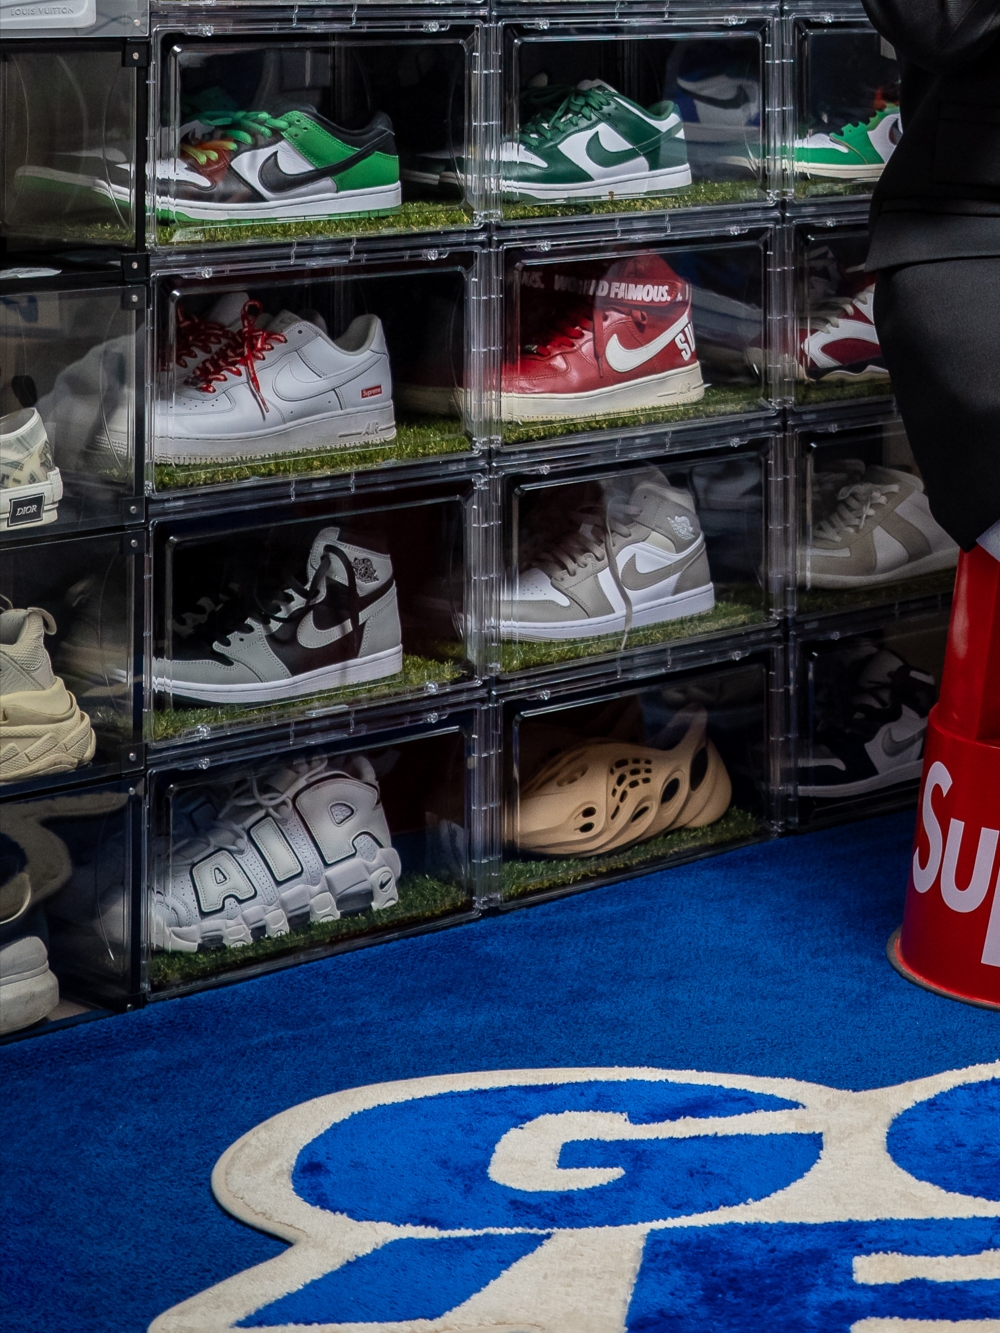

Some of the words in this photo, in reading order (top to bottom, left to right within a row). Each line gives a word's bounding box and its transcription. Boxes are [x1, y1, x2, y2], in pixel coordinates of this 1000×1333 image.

[11, 8, 35, 16] LOUIS
[39, 7, 74, 16] VUITTON
[609, 281, 671, 303] FAMOUS.
[674, 321, 696, 362] SU
[363, 387, 381, 397] Supreme
[362, 421, 379, 437] AIR
[16, 504, 38, 516] DIOR
[191, 772, 394, 915] AIR
